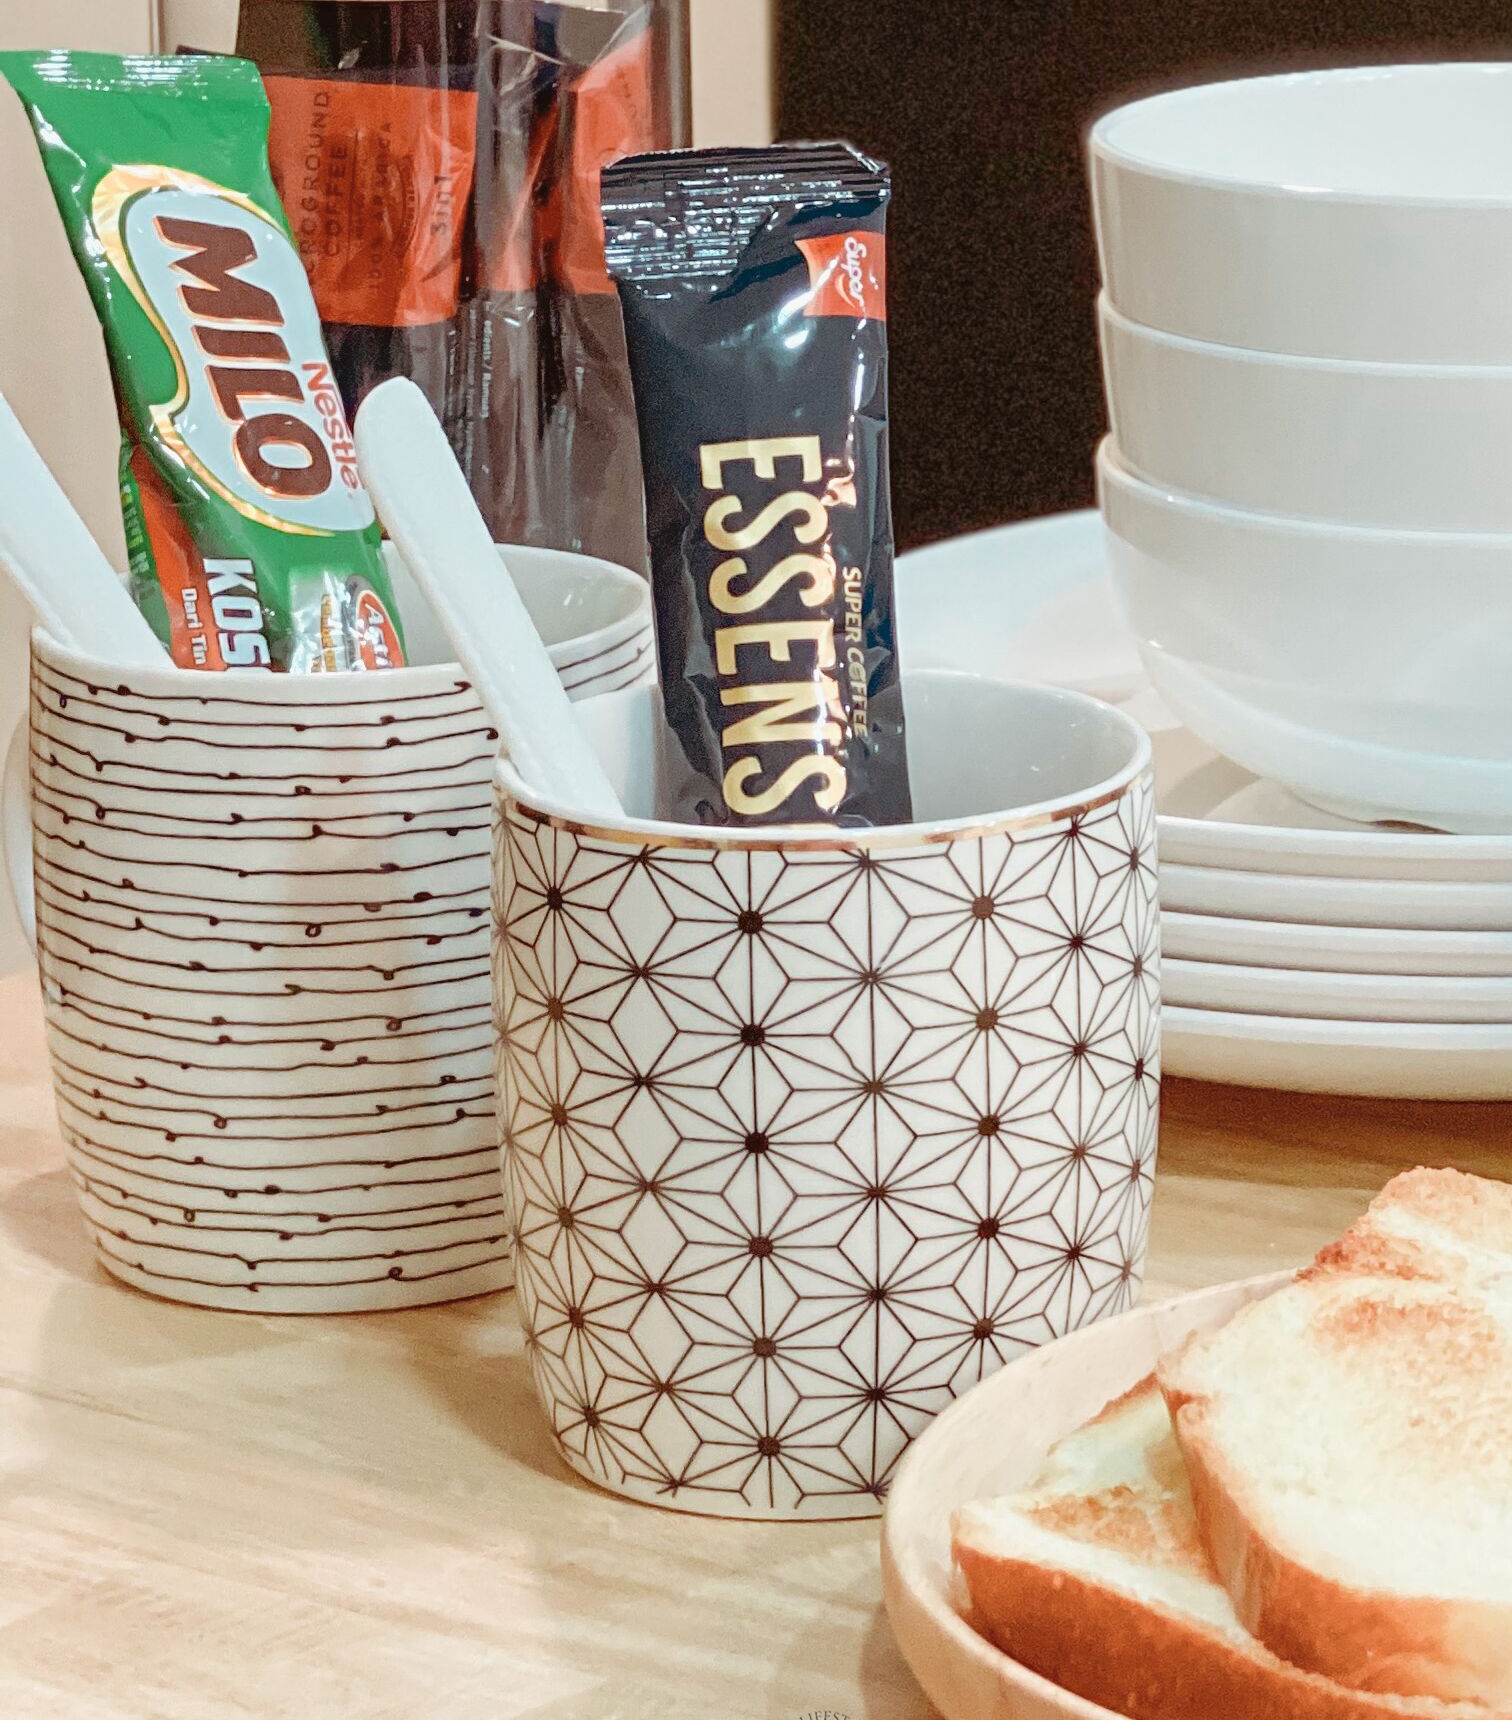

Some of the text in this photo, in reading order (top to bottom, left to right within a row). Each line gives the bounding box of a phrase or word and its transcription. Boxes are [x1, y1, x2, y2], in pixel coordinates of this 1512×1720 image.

[324, 143, 349, 257] COFFEE
[152, 215, 333, 500] MILO
[181, 587, 204, 629] Dari
[202, 557, 272, 673] KOS
[699, 434, 848, 828] ESSENS
[842, 566, 869, 738] SUPER COFFEE
